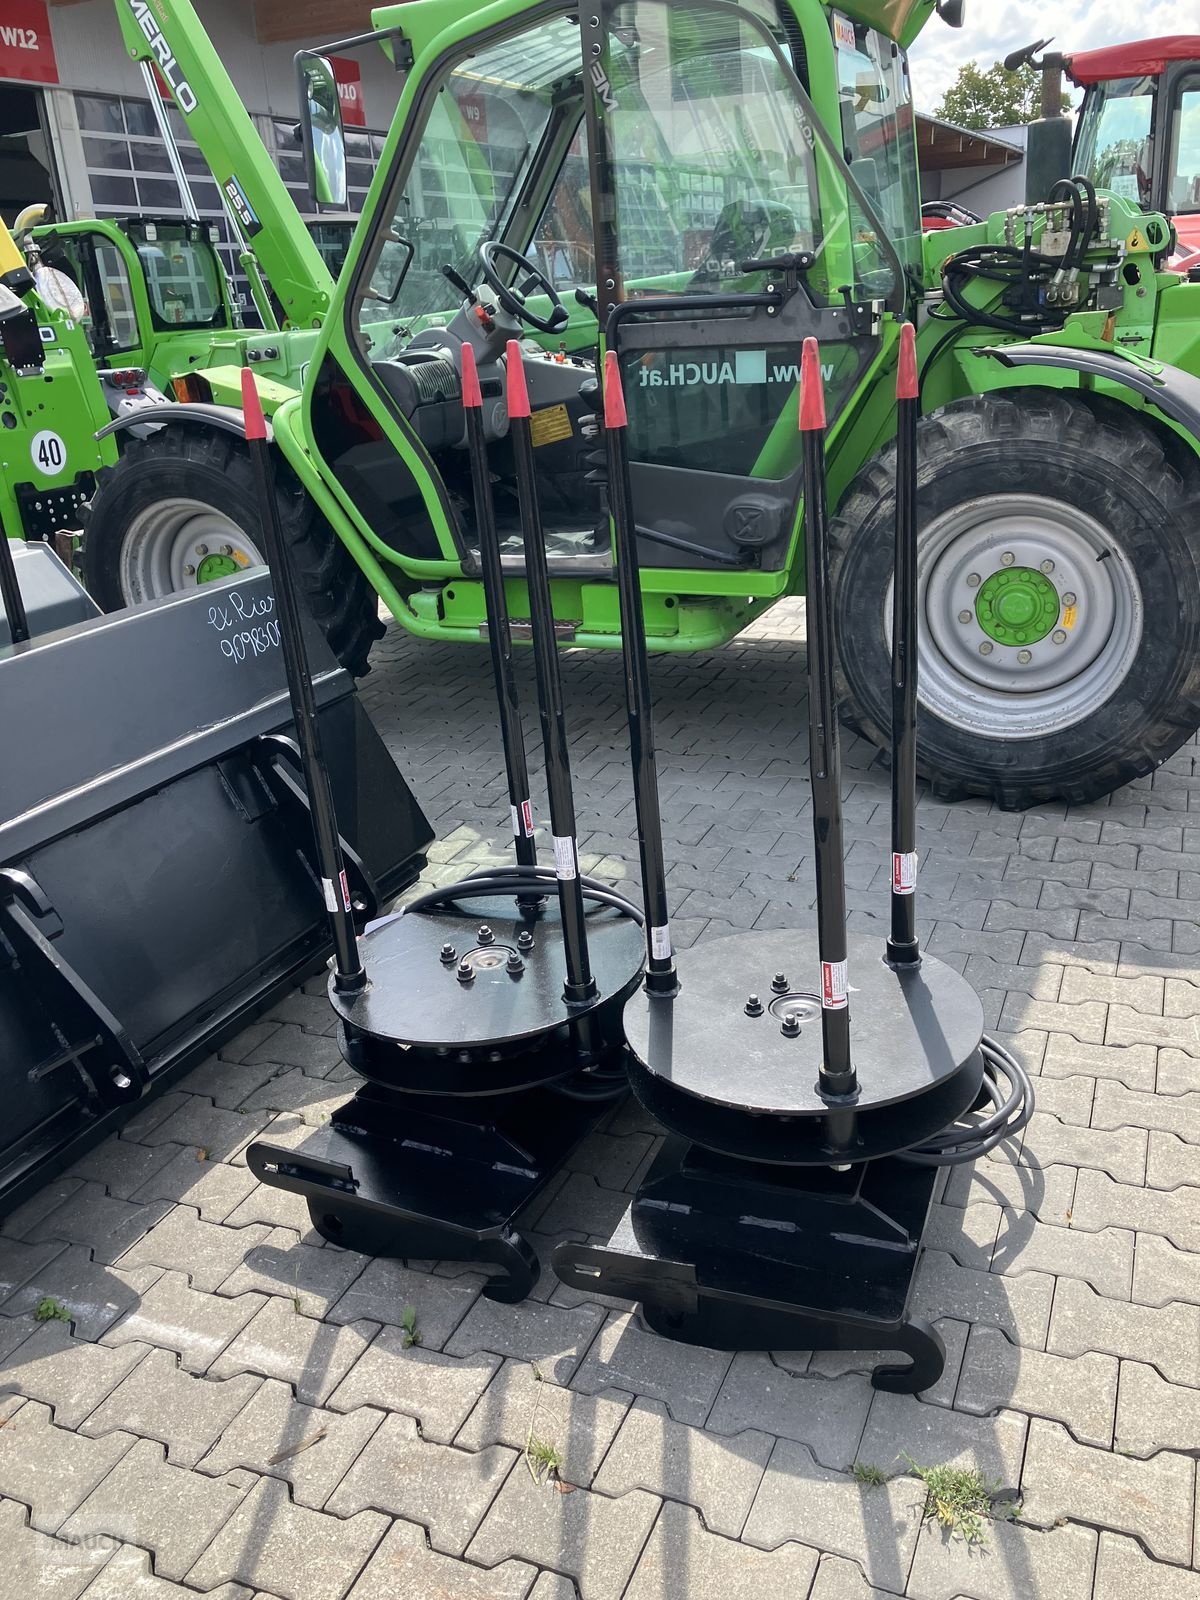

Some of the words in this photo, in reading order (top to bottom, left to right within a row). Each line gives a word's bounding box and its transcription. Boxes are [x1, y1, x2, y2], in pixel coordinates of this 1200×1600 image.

[0, 26, 39, 50] W12
[130, 0, 197, 113] MERLO
[225, 182, 253, 226] 25.5
[38, 438, 61, 467] 40
